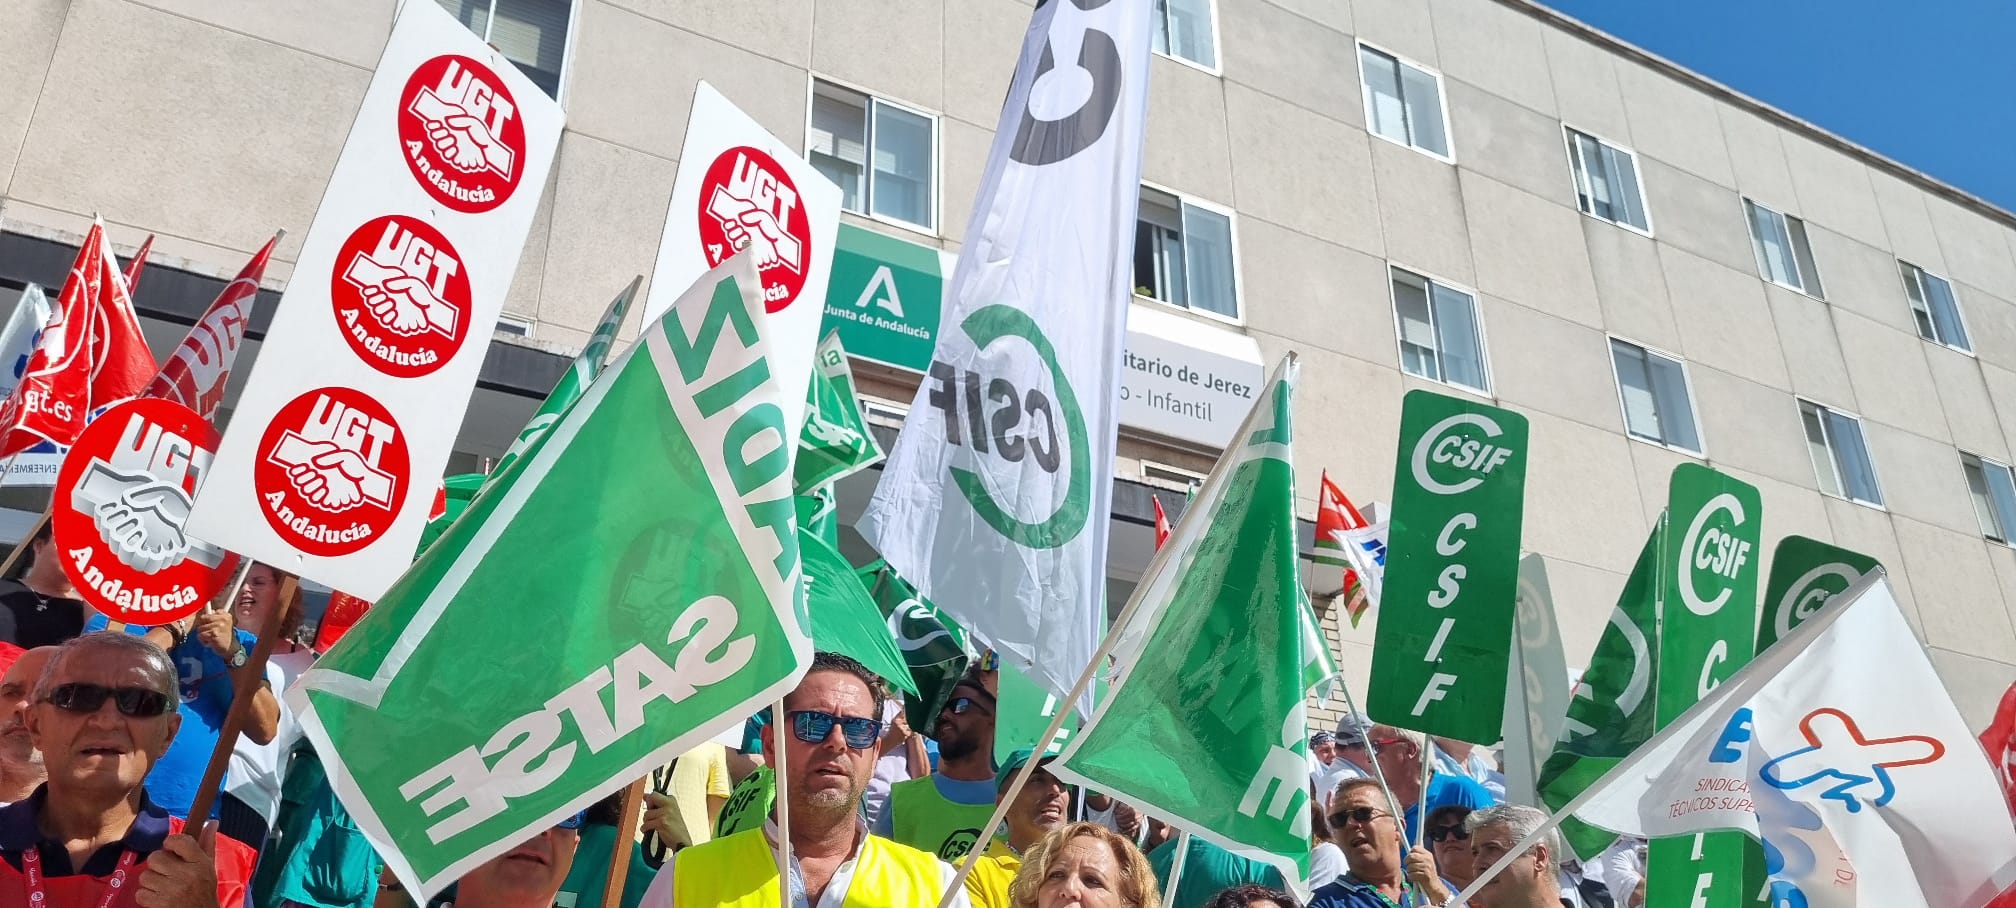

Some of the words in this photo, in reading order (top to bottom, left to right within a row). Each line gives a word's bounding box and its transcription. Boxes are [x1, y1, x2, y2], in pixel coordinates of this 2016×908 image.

[435, 59, 514, 140] UGT
[406, 139, 495, 203] Andalucía
[727, 152, 796, 232] UGT
[372, 219, 458, 298] UGT
[340, 308, 438, 366] Andalucía
[824, 303, 857, 321] Junta
[859, 313, 873, 325] de
[875, 317, 930, 340] Andalucía
[1148, 388, 1212, 422] Infantil
[1177, 365, 1199, 386] de
[1204, 373, 1251, 399] Jerez
[300, 393, 395, 469] UGT
[1432, 434, 1513, 474] CSIF
[265, 490, 372, 543] Andalucía
[69, 545, 199, 613] Andalucía
[1695, 527, 1751, 580] CSIF
[1411, 512, 1477, 717] CSIF
[1695, 778, 1752, 794] SINDICA
[1718, 798, 1756, 814] SUPE
